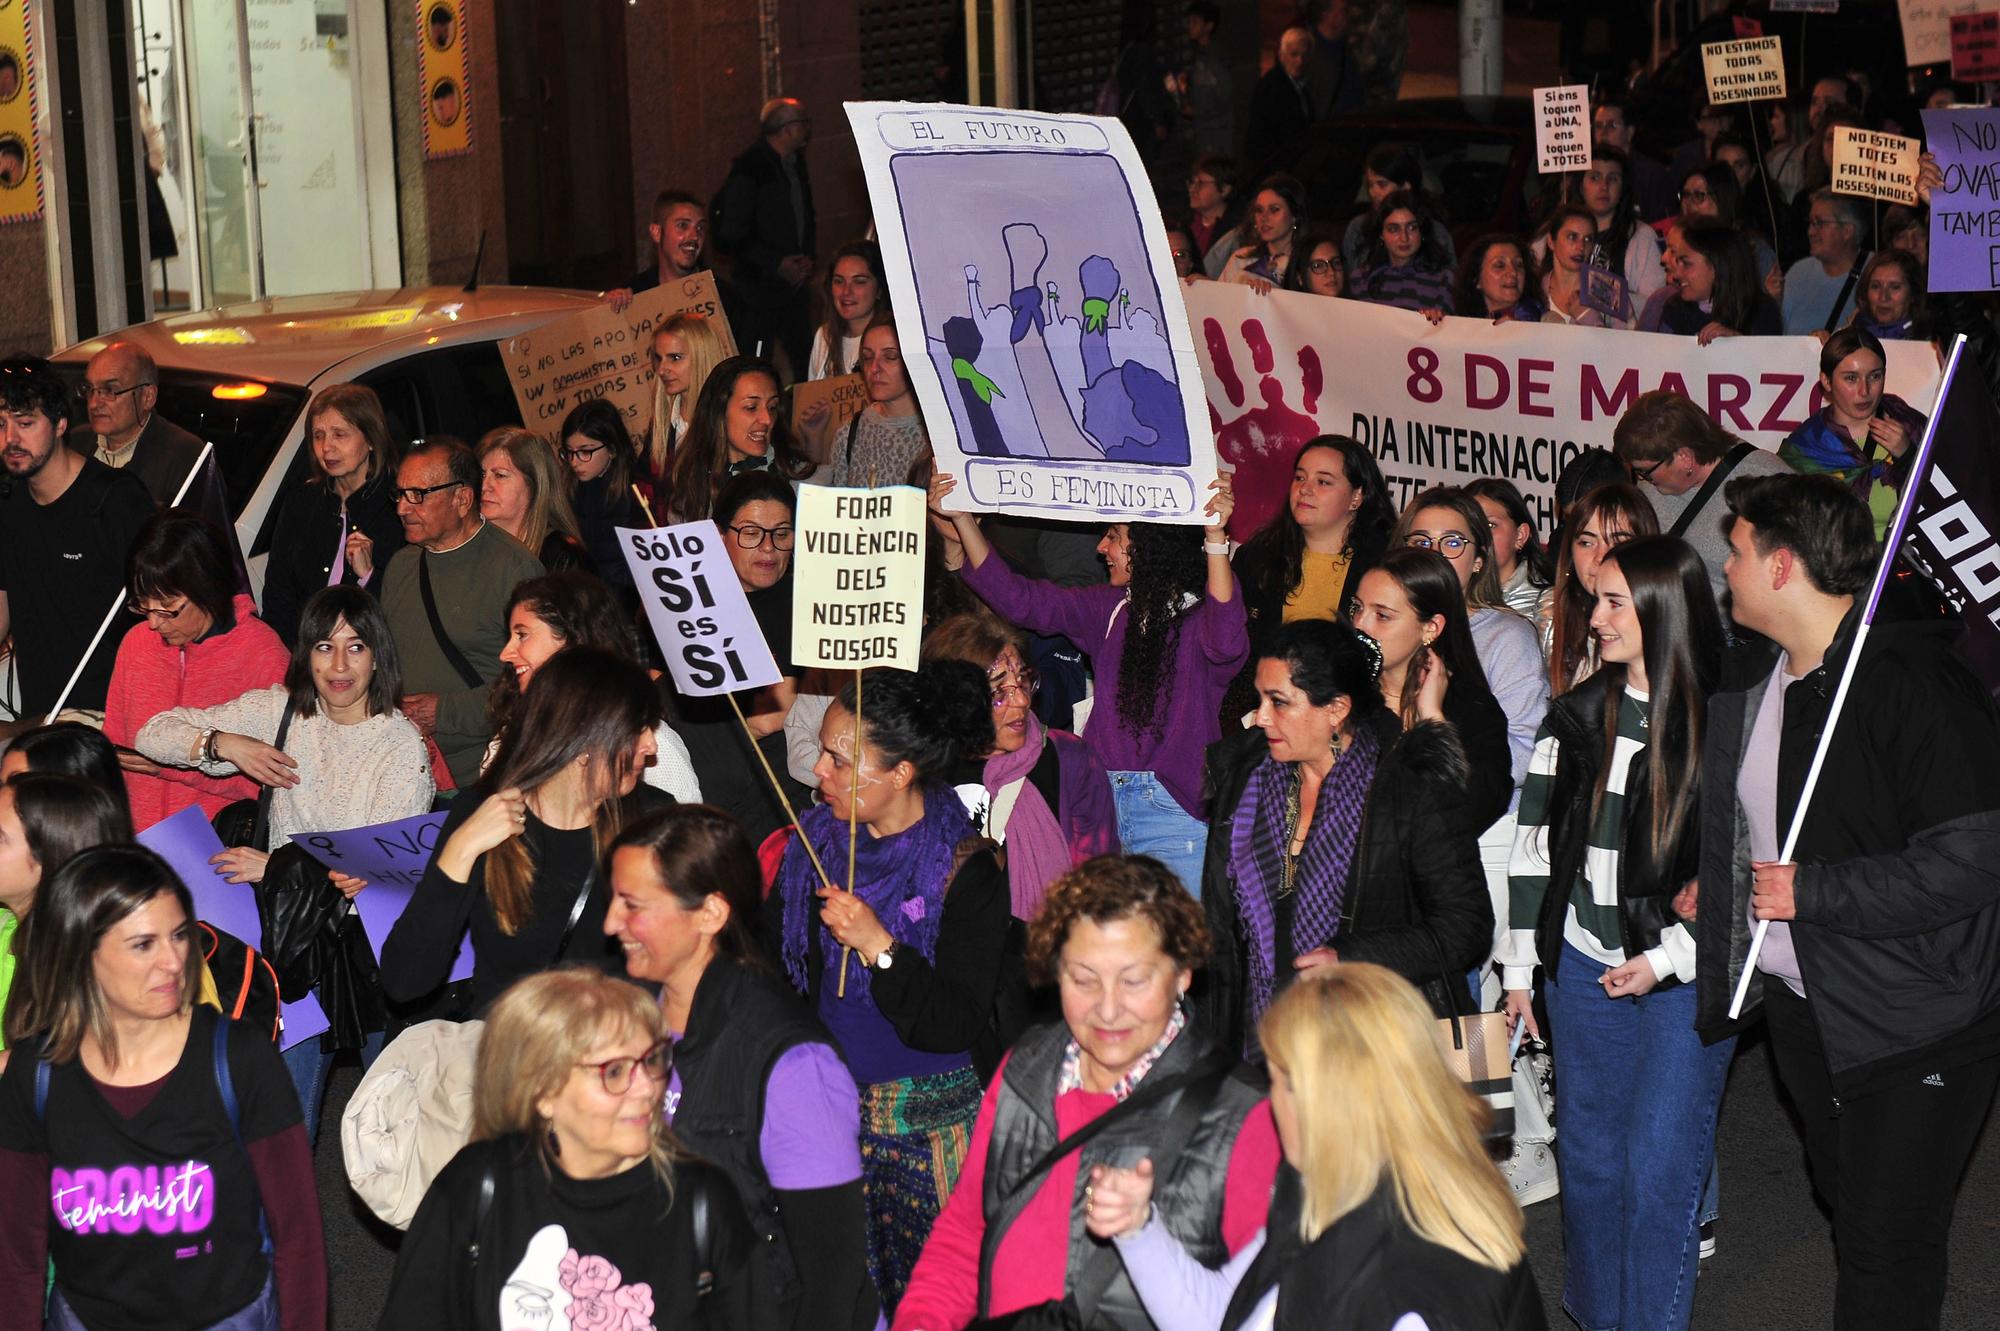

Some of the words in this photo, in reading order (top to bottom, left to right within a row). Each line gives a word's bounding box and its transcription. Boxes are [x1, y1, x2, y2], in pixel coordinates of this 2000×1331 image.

[1706, 45, 1722, 56] NO
[1725, 38, 1776, 54] ESTAMOS
[1725, 55, 1762, 68] TODAS
[1713, 73, 1756, 87] FALTAN
[1758, 71, 1779, 82] LAS
[1545, 91, 1556, 102] Si
[1558, 91, 1578, 100] ens
[1712, 85, 1782, 102] ASESINADAS
[1543, 104, 1581, 117] toquen
[1545, 120, 1552, 128] a
[1554, 115, 1582, 127] UNA,
[910, 121, 945, 140] EL
[964, 121, 1067, 145] FUTURO
[1554, 131, 1574, 140] ens
[1848, 131, 1867, 144] NO
[1870, 134, 1907, 151] ESTEM
[1951, 121, 1997, 153] NO
[1543, 159, 1550, 167] a
[1553, 154, 1587, 166] TOTES
[1546, 143, 1584, 156] toquen
[1857, 146, 1897, 165] TOTES
[1890, 172, 1912, 186] LAS
[518, 364, 532, 379] SI
[538, 354, 555, 371] NO
[561, 342, 585, 360] LAS
[525, 384, 545, 401] UN
[621, 352, 640, 367] DE
[1405, 346, 1443, 404] 8
[1464, 352, 1555, 418] DE
[539, 398, 566, 419] CON
[636, 368, 656, 385] LA
[1352, 412, 1399, 462] DIA
[1407, 421, 1604, 484] INTERNACIO
[997, 470, 1034, 499] ES
[1051, 475, 1180, 509] FEMINISTA
[836, 495, 892, 520] FORA
[632, 532, 705, 561] Sólo
[805, 527, 918, 556] VIOLÈNCIA
[652, 560, 717, 613] Sí
[836, 566, 886, 591] DELS
[812, 601, 906, 626] NOSTRES
[677, 616, 719, 638] es
[818, 636, 898, 661] COSSOS
[682, 636, 748, 689] Sí
[373, 822, 442, 859] NO
[51, 1163, 215, 1236] PROUD
